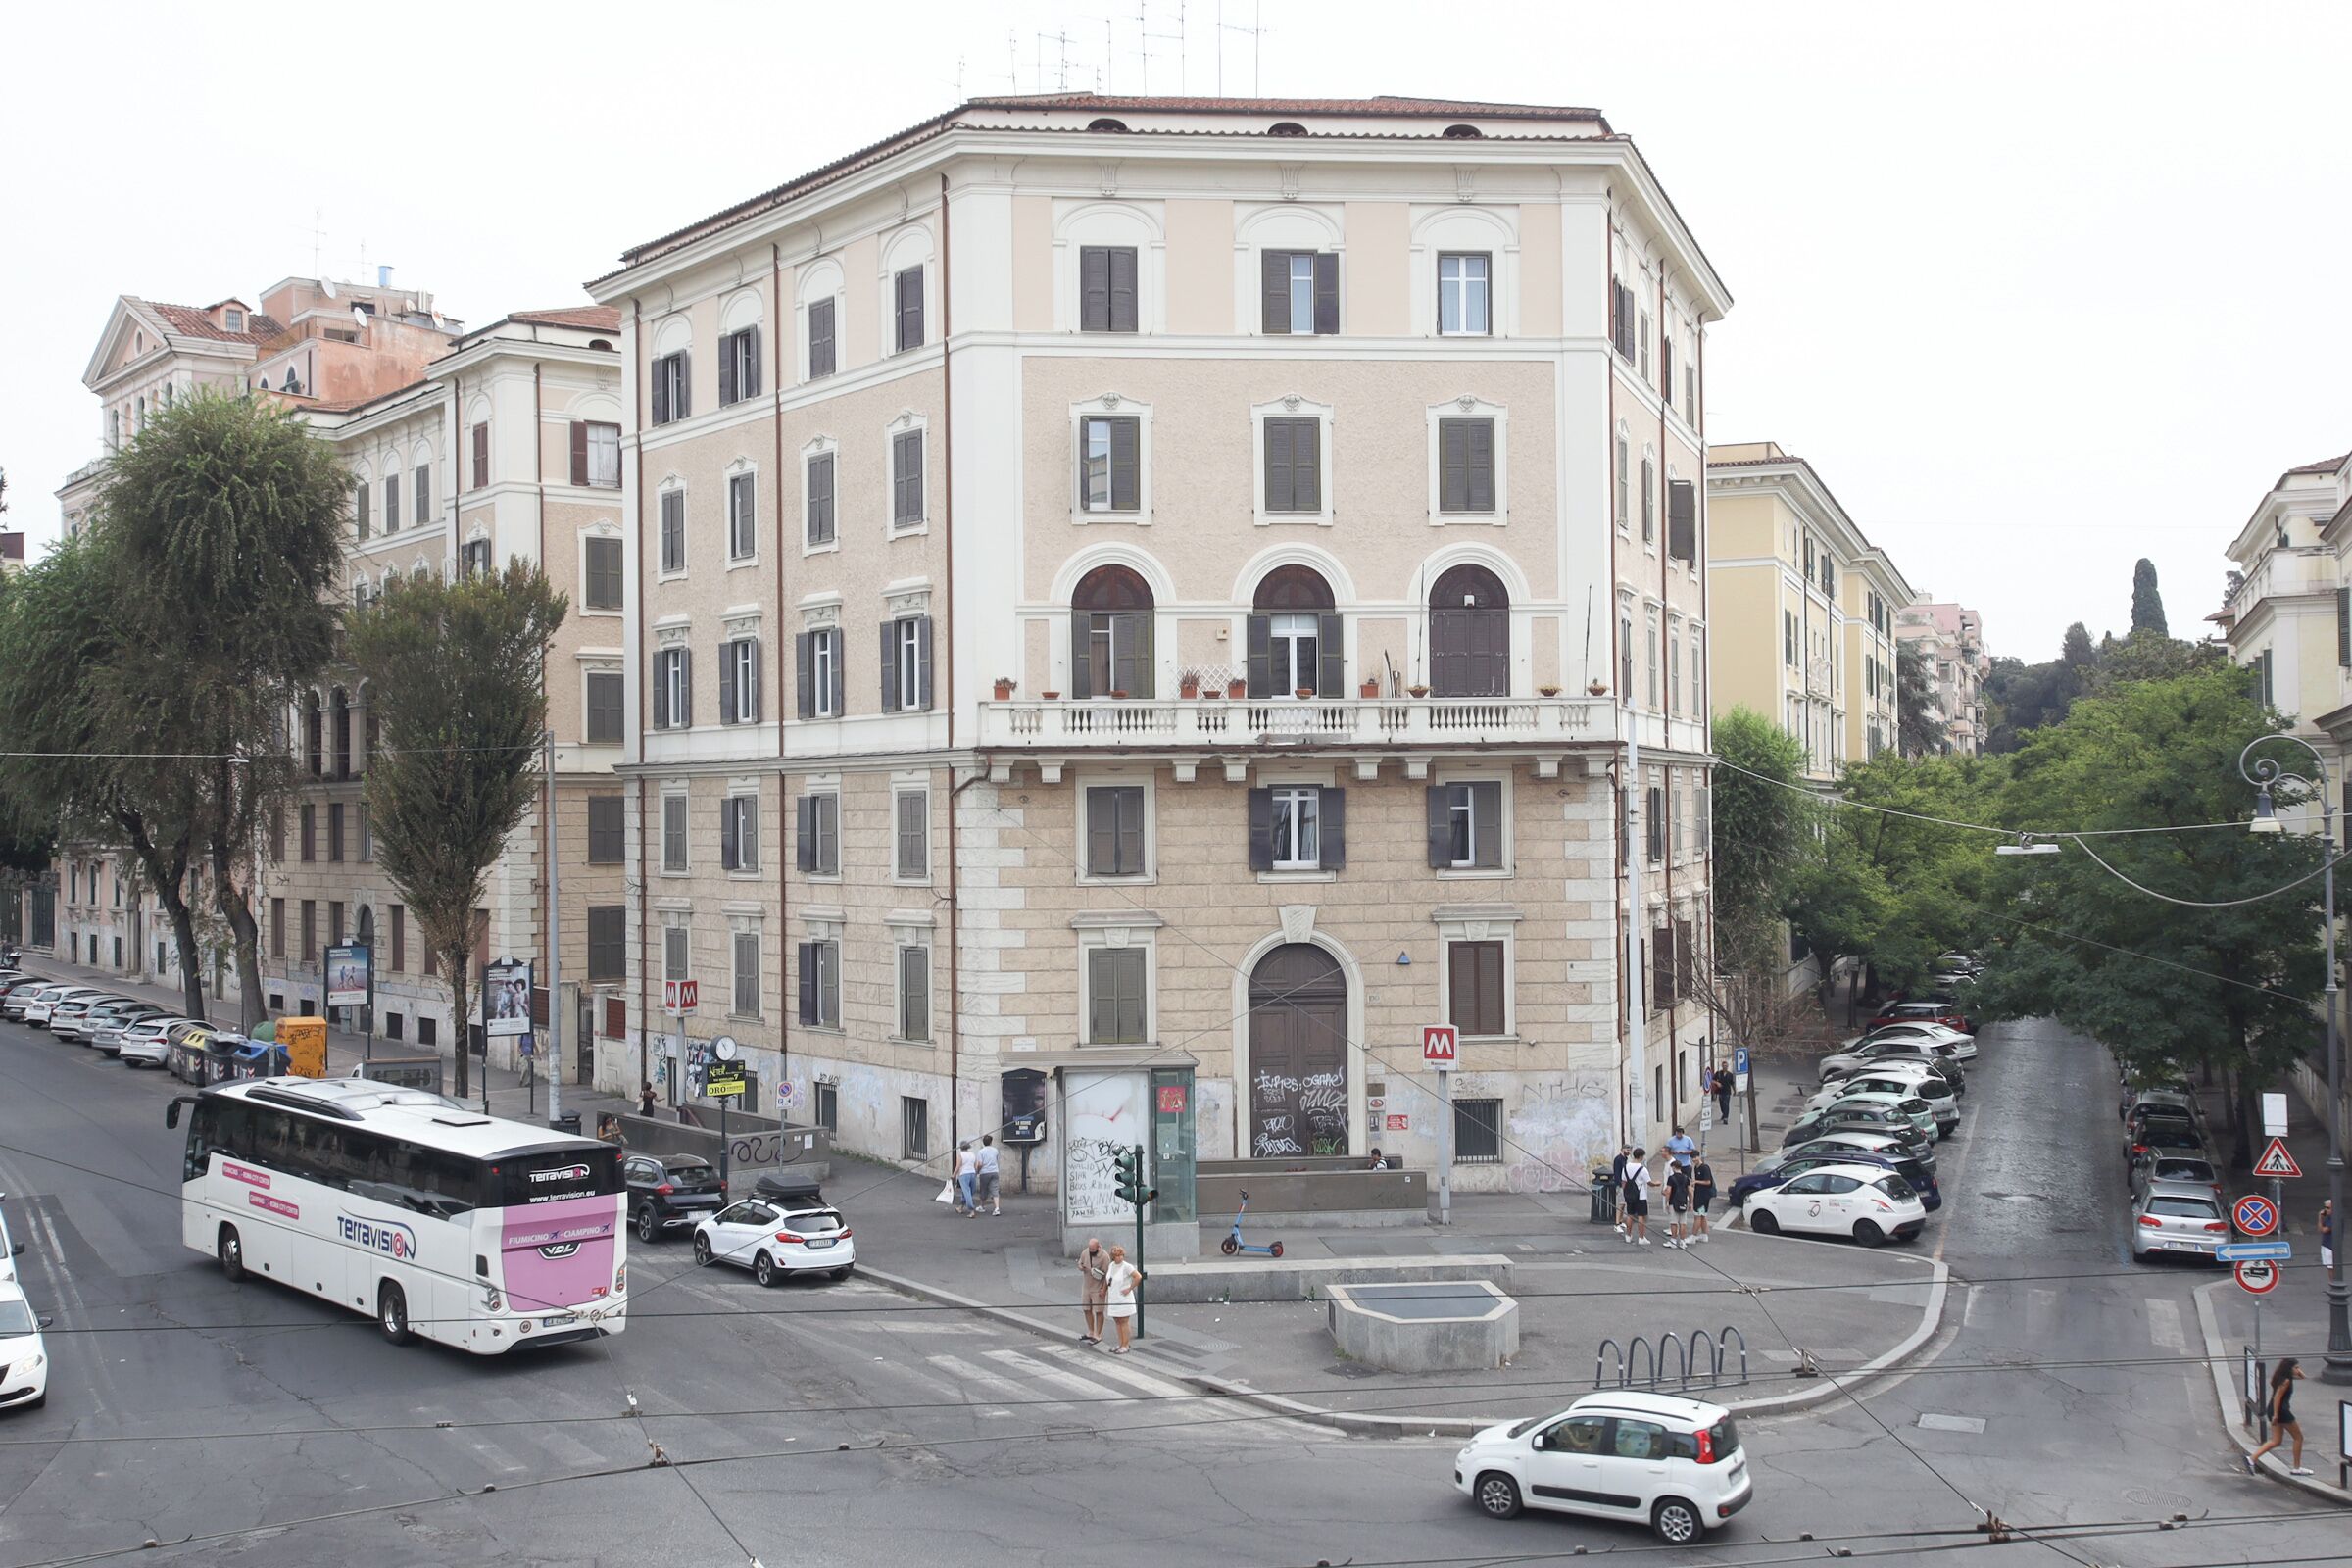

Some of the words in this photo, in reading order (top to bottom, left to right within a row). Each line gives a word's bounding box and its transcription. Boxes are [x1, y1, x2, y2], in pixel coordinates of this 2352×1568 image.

[681, 985, 696, 1004] M
[1426, 1033, 1452, 1054] M
[1737, 1051, 1745, 1071] P
[709, 1086, 726, 1095] ORO
[529, 1190, 596, 1203] www.terravision.eu
[509, 1233, 549, 1245] FIUMICINO
[564, 1226, 600, 1238] CIAMPINO
[545, 1243, 574, 1255] VDL
